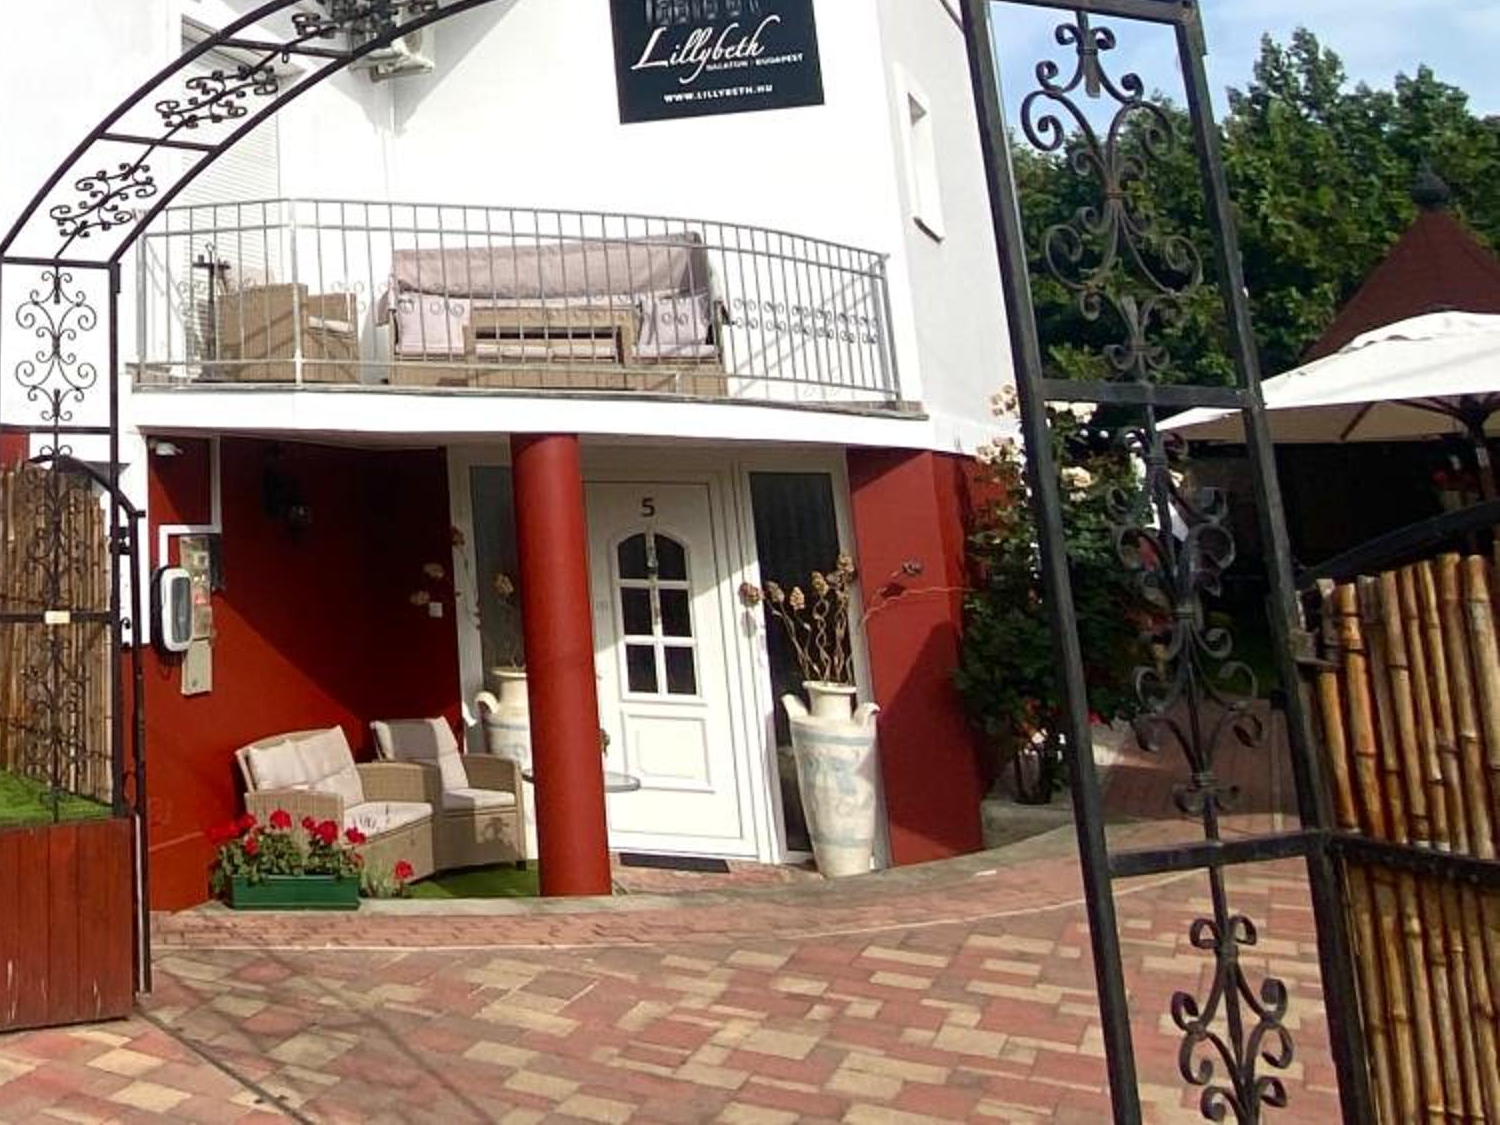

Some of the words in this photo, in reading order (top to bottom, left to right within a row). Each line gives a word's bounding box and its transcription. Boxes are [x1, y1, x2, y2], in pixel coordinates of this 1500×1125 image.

[631, 15, 781, 84] Lillybeth
[756, 53, 803, 66] BUDAPEST
[663, 84, 773, 103] WWW.LILLYBETH.HU
[641, 497, 656, 517] 5
